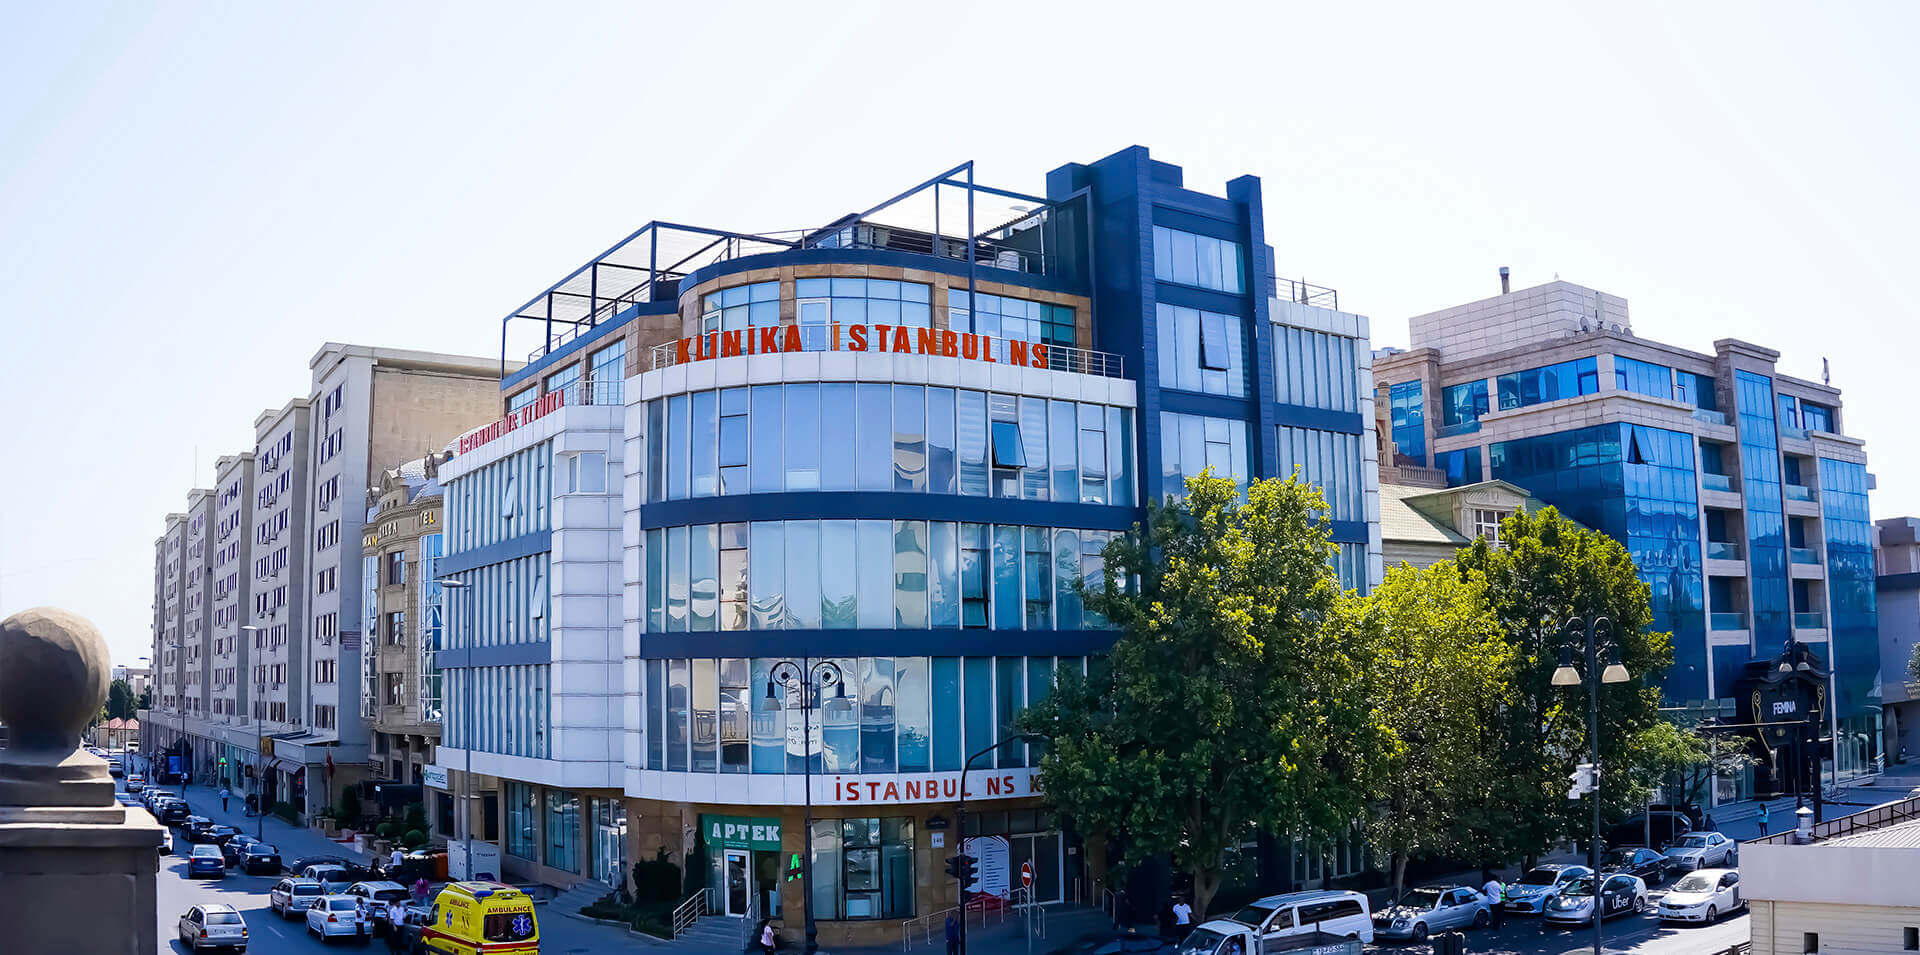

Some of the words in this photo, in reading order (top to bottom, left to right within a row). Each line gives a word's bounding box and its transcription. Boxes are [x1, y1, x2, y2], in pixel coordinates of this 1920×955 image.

[677, 325, 802, 365] KLİNİKA
[833, 321, 997, 362] İSTANBUL
[1010, 340, 1048, 369] NS
[987, 776, 1014, 795] NS
[712, 822, 780, 841] APTEK
[487, 905, 532, 914] AMBULANCE
[1612, 895, 1630, 909] Uber
